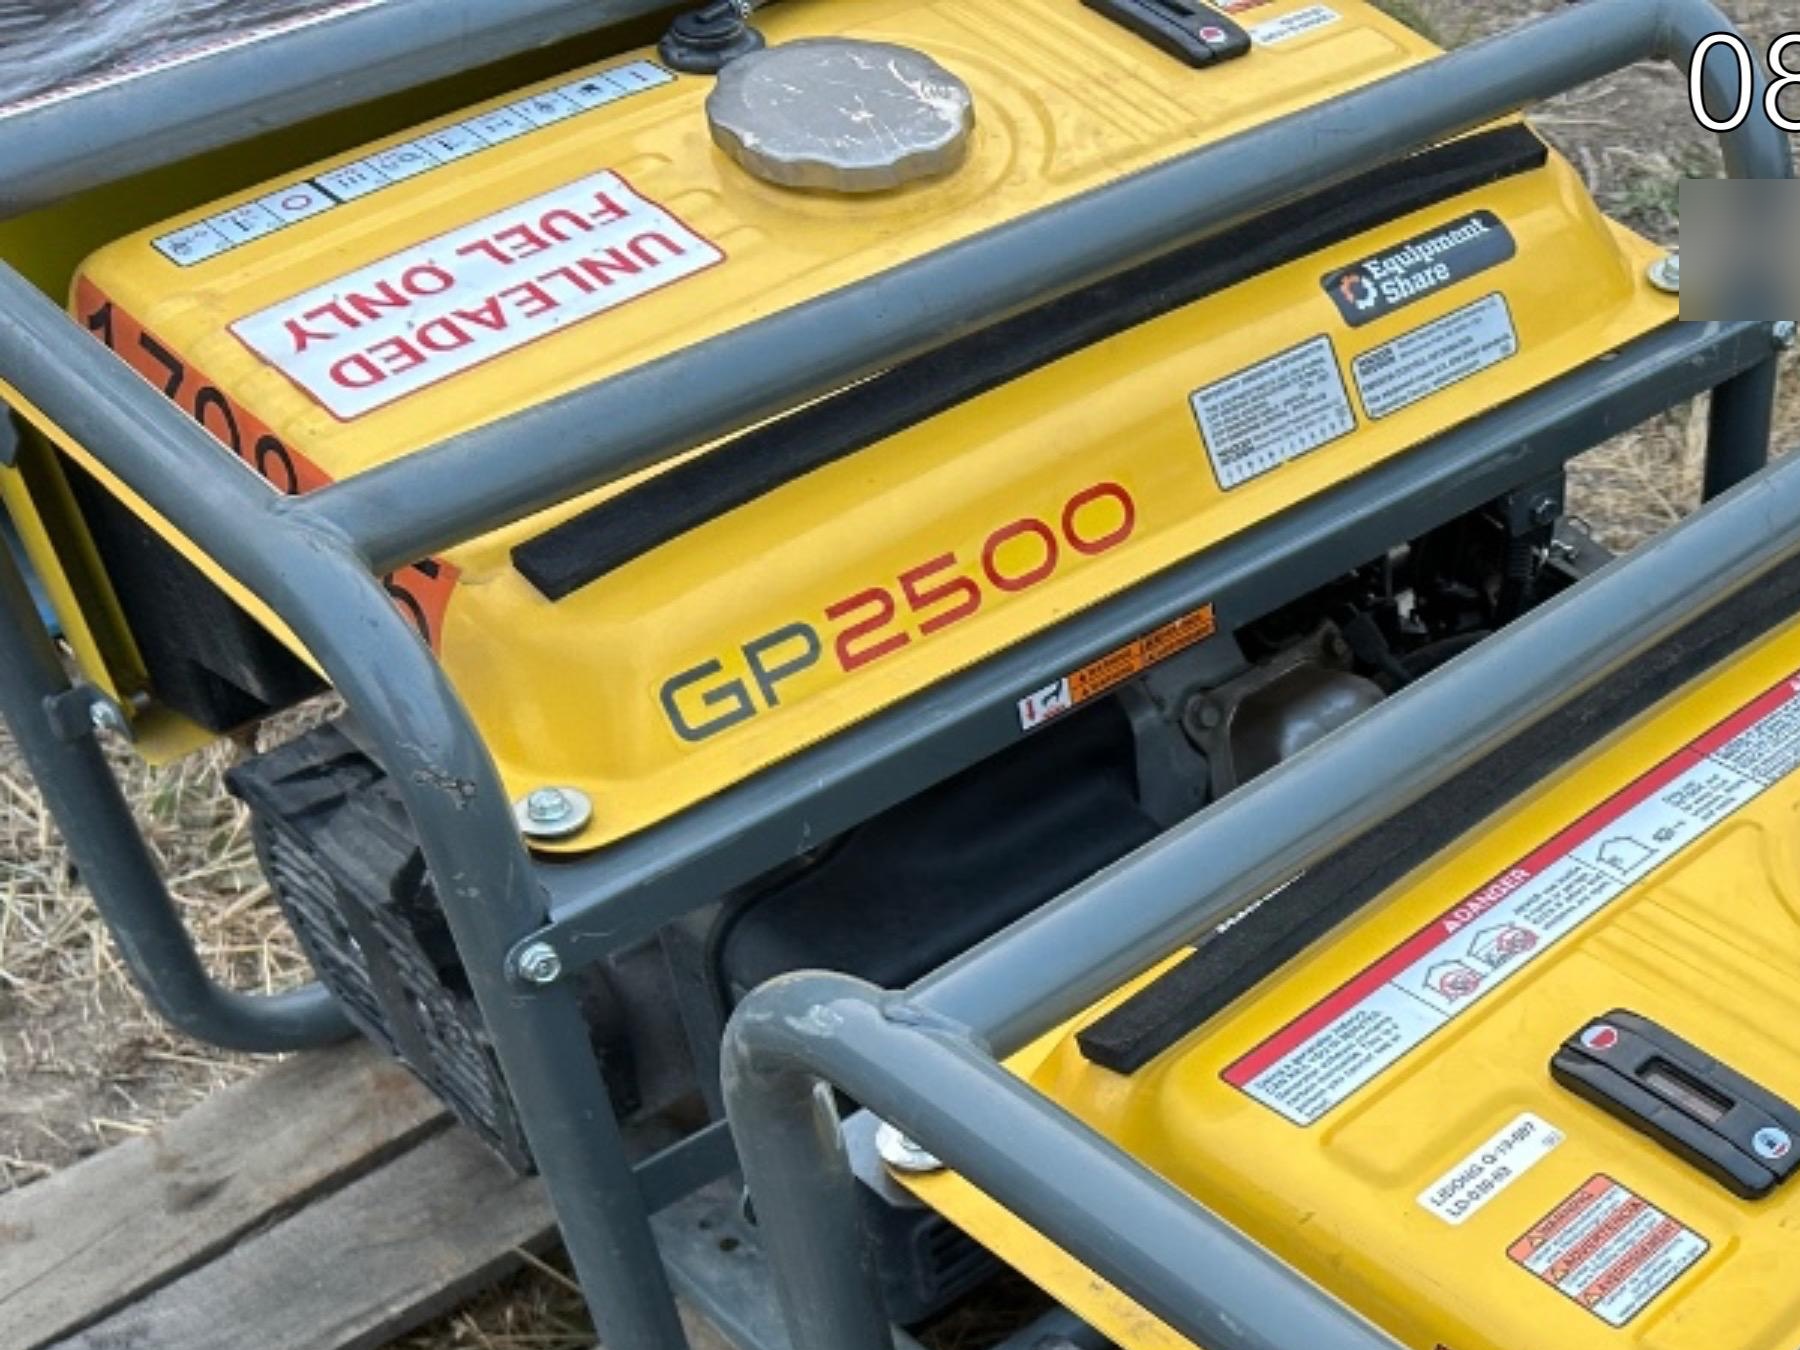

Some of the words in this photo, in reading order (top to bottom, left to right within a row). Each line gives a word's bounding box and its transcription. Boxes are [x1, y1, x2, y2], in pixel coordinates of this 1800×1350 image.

[453, 190, 631, 275] FUEL
[1362, 218, 1491, 281] Equipment
[282, 264, 456, 355] ONLY
[328, 230, 687, 390] UNLEADED
[1381, 262, 1450, 304] Share
[659, 481, 1137, 742] GP2500
[1455, 868, 1532, 925] DANGER
